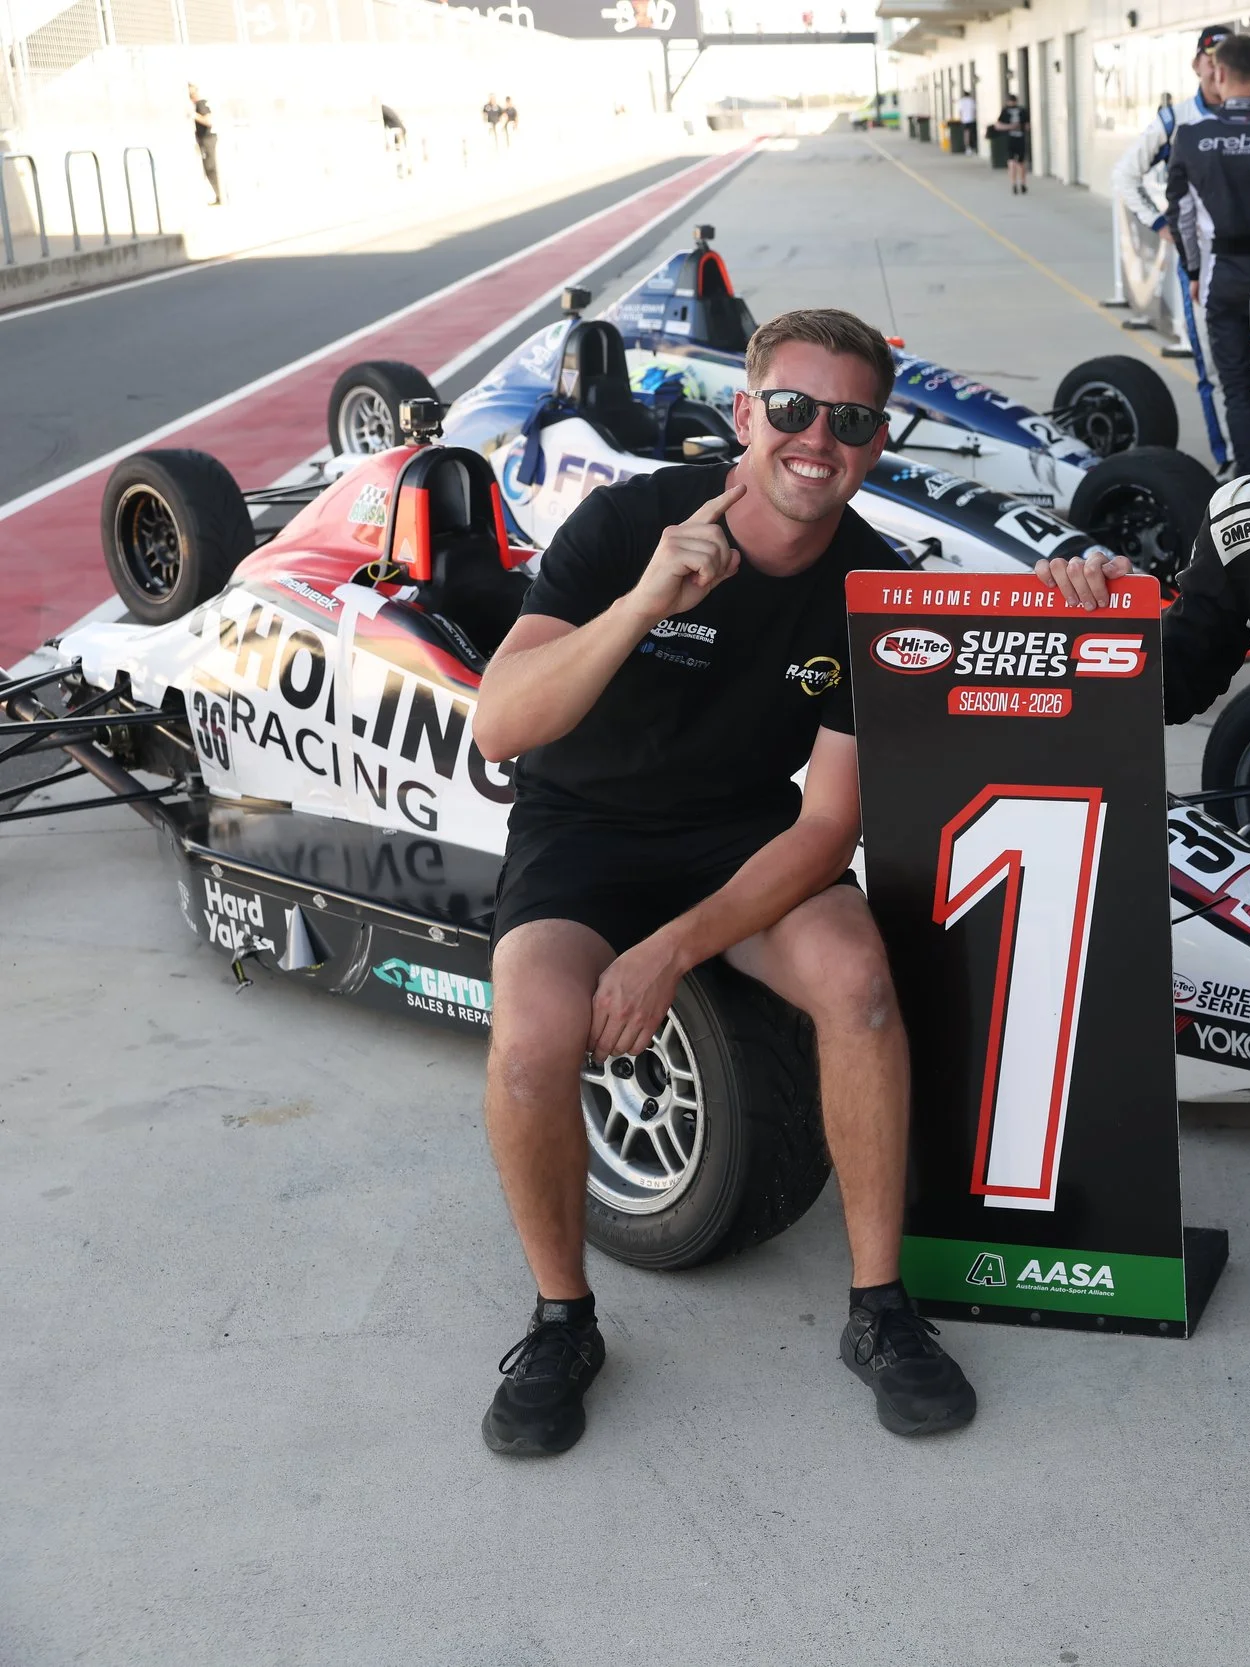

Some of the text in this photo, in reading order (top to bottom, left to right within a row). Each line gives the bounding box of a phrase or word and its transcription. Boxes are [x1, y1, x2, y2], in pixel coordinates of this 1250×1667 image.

[882, 589, 912, 605] THE
[922, 590, 971, 606] HOME
[981, 591, 1001, 607] OF
[1010, 592, 1055, 608] PURE
[656, 619, 718, 640] OLINGER
[900, 637, 950, 653] Hi-Tec
[961, 631, 1068, 655] SUPER
[899, 653, 930, 666] Oils
[954, 652, 1069, 678] SERIES
[959, 692, 1009, 712] SEASON
[1010, 693, 1020, 711] 4
[1029, 694, 1063, 714] 2026
[194, 690, 231, 772] 36
[231, 688, 438, 832] RACING
[204, 878, 264, 928] Hard
[932, 783, 1108, 1212] 1
[1173, 980, 1194, 993] i-Tec
[406, 993, 443, 1013] SALES
[447, 1004, 456, 1017] &
[1016, 1259, 1115, 1289] AASA
[1016, 1283, 1115, 1297] Australian Auto-Sport Alliance
